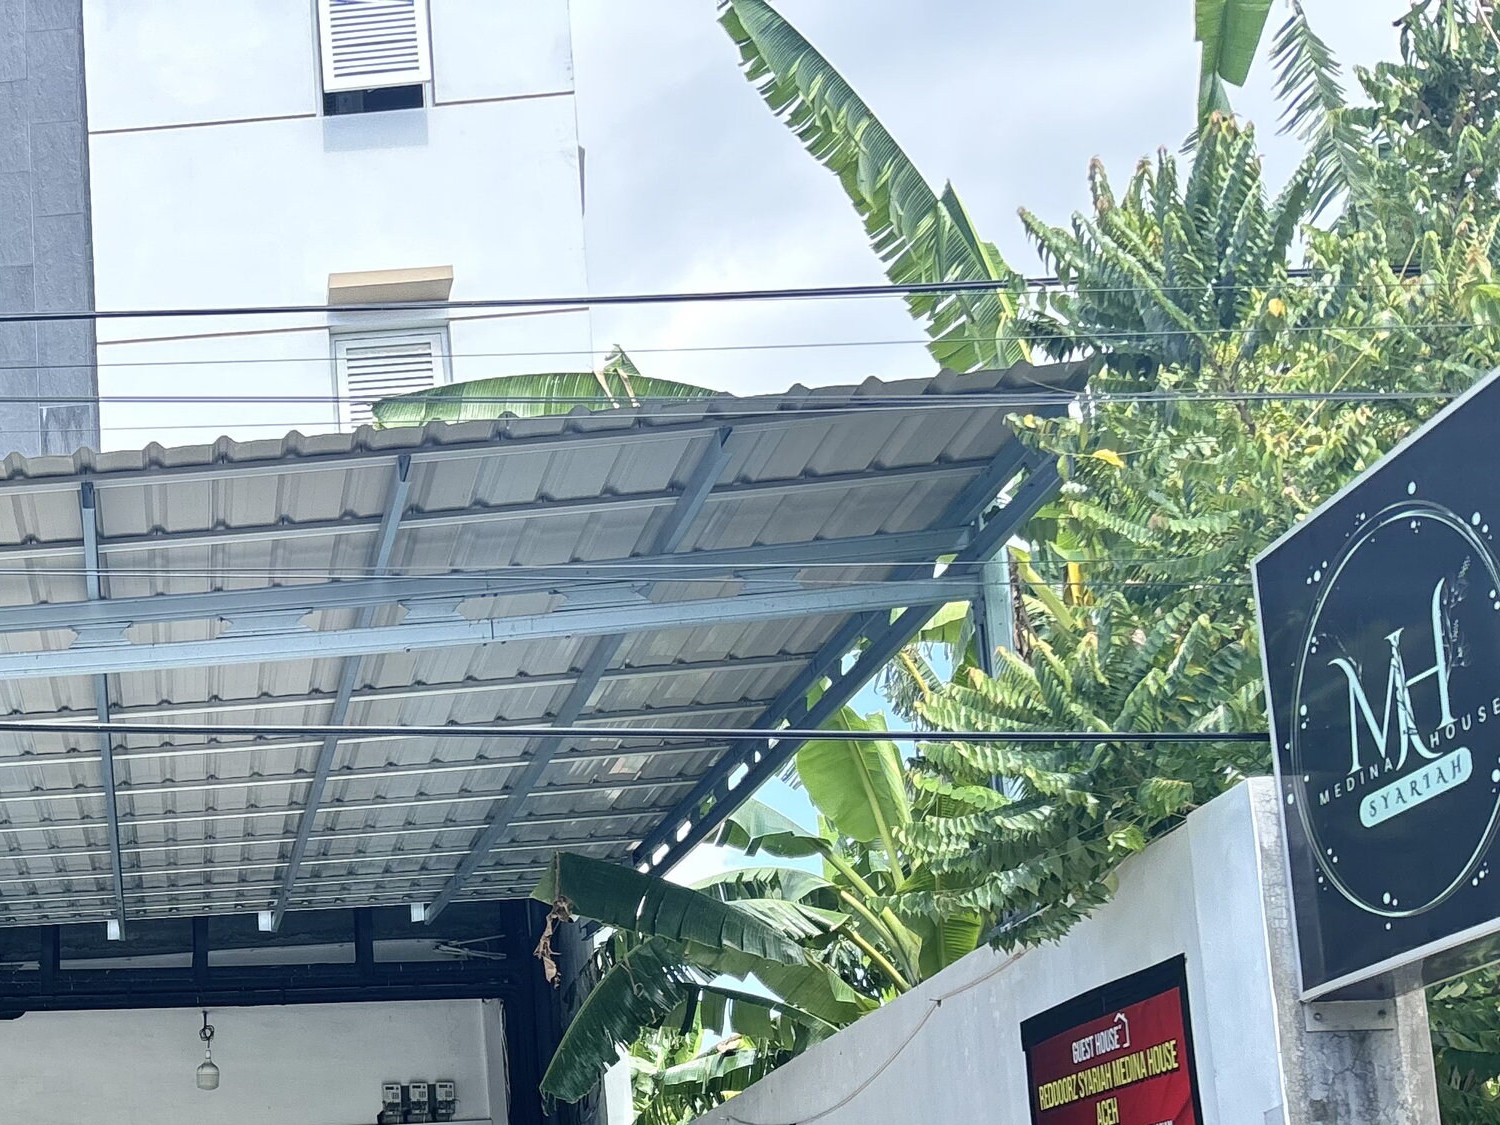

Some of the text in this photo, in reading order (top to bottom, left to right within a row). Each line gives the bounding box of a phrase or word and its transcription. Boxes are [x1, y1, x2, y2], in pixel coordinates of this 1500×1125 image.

[1319, 697, 1500, 806] MEDINA HOUSE
[1369, 754, 1464, 818] SYARIAH
[1039, 1040, 1178, 1110] REDDOORZ SYARIAH MEDINA HOUSE
[1072, 1027, 1120, 1063] GUEST HOUSE
